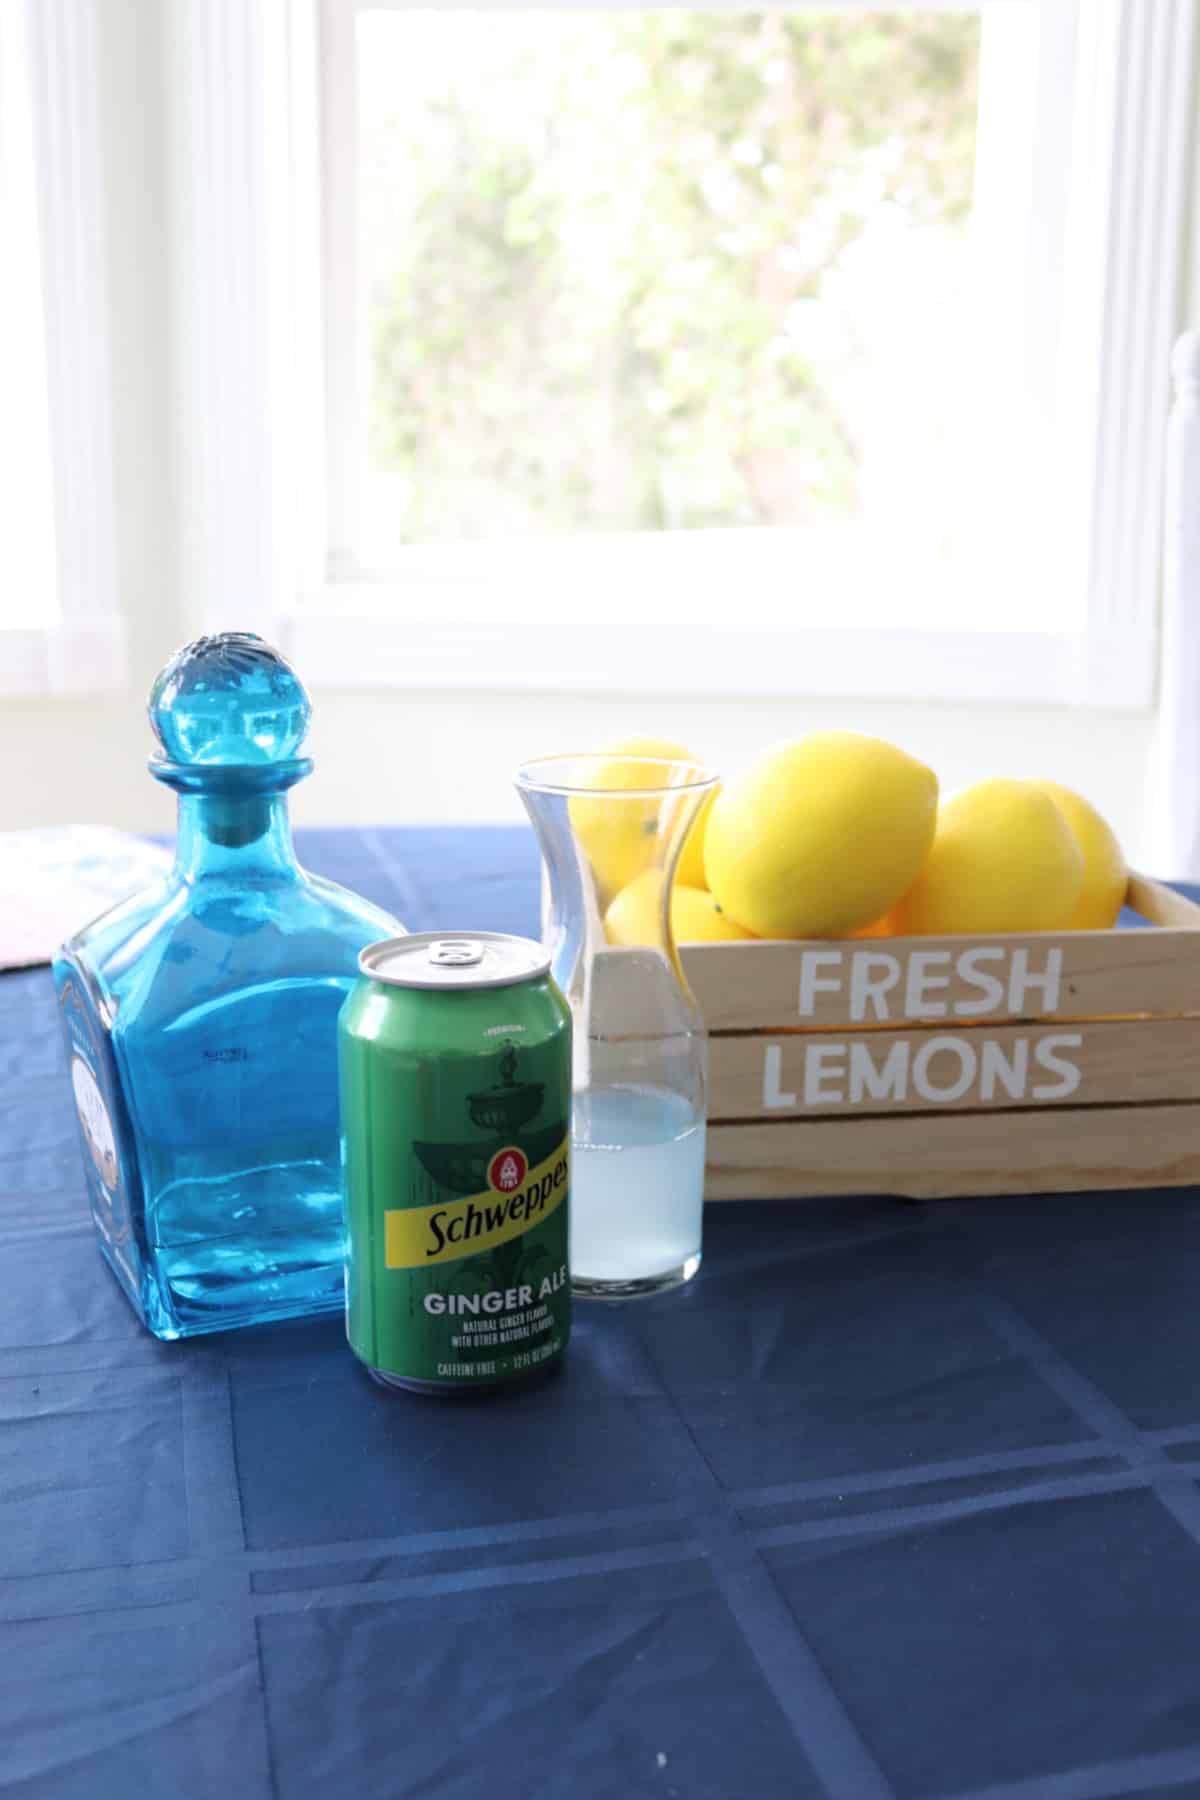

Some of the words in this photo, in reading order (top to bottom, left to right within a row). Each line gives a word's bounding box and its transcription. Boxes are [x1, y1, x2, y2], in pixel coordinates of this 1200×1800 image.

[797, 947, 1063, 1022] FRESH
[762, 1034, 1083, 1109] LEMONS
[423, 1285, 533, 1315] GINGER
[538, 1264, 566, 1299] ALE
